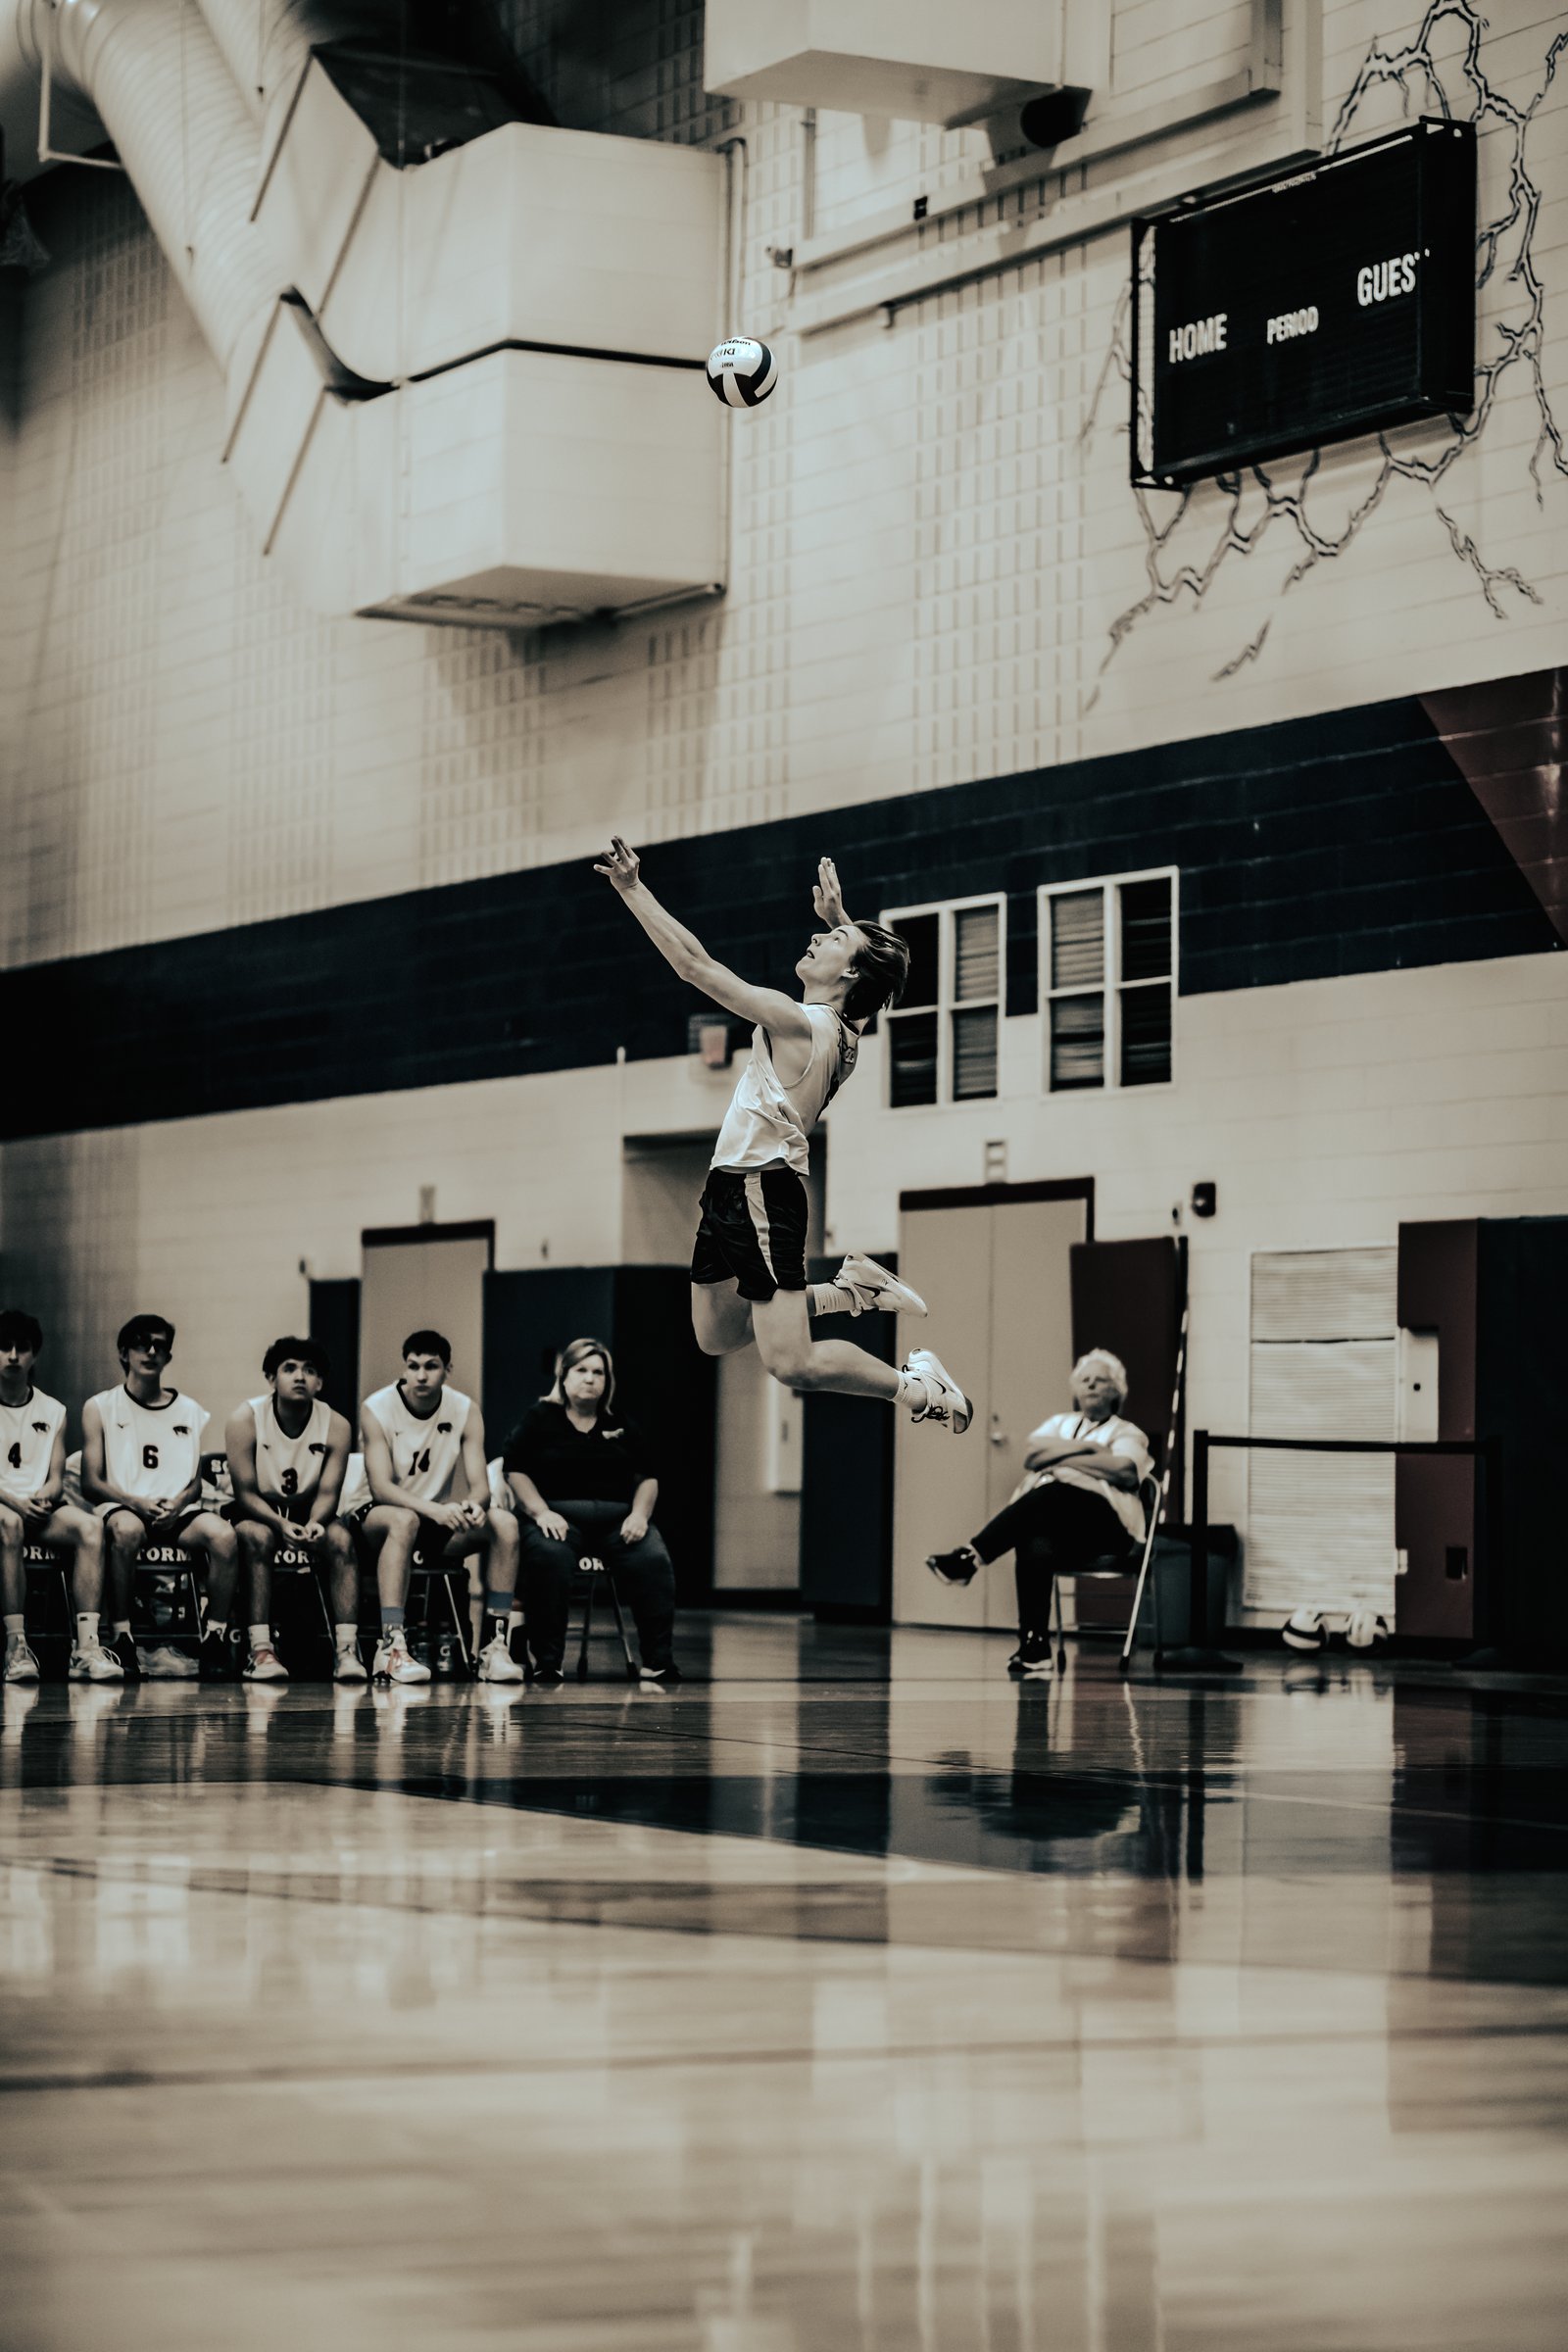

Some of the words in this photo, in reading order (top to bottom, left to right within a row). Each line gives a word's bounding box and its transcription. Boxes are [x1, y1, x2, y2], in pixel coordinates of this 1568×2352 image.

[1357, 248, 1430, 307] GUES
[1169, 314, 1227, 364] HOME
[1266, 306, 1319, 345] PERIOD
[8, 1442, 22, 1469] 4
[143, 1445, 158, 1469] 6
[281, 1467, 298, 1495] 3
